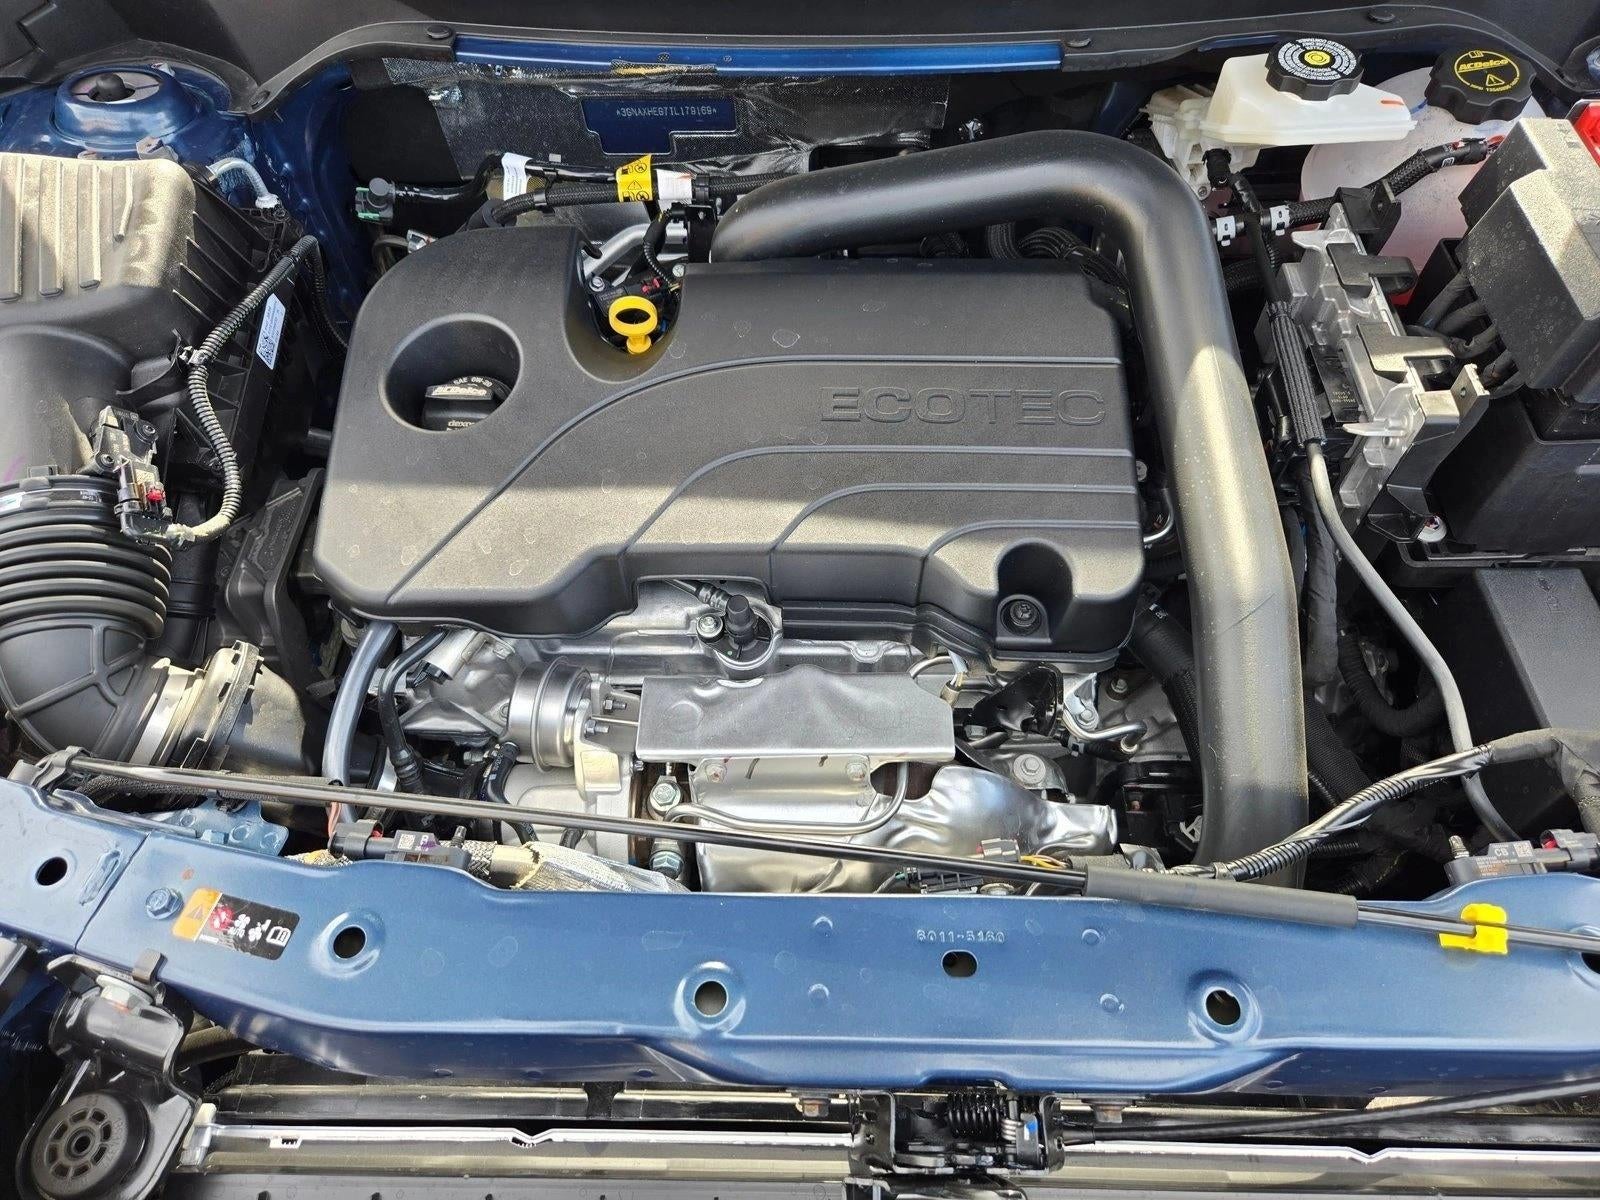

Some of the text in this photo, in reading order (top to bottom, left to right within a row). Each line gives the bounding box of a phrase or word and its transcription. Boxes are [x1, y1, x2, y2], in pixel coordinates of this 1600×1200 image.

[1458, 59, 1509, 71] ACDelco
[453, 376, 493, 388] SAE 0W-20
[431, 385, 488, 396] ACDelco
[819, 386, 1107, 426] ECOTEC
